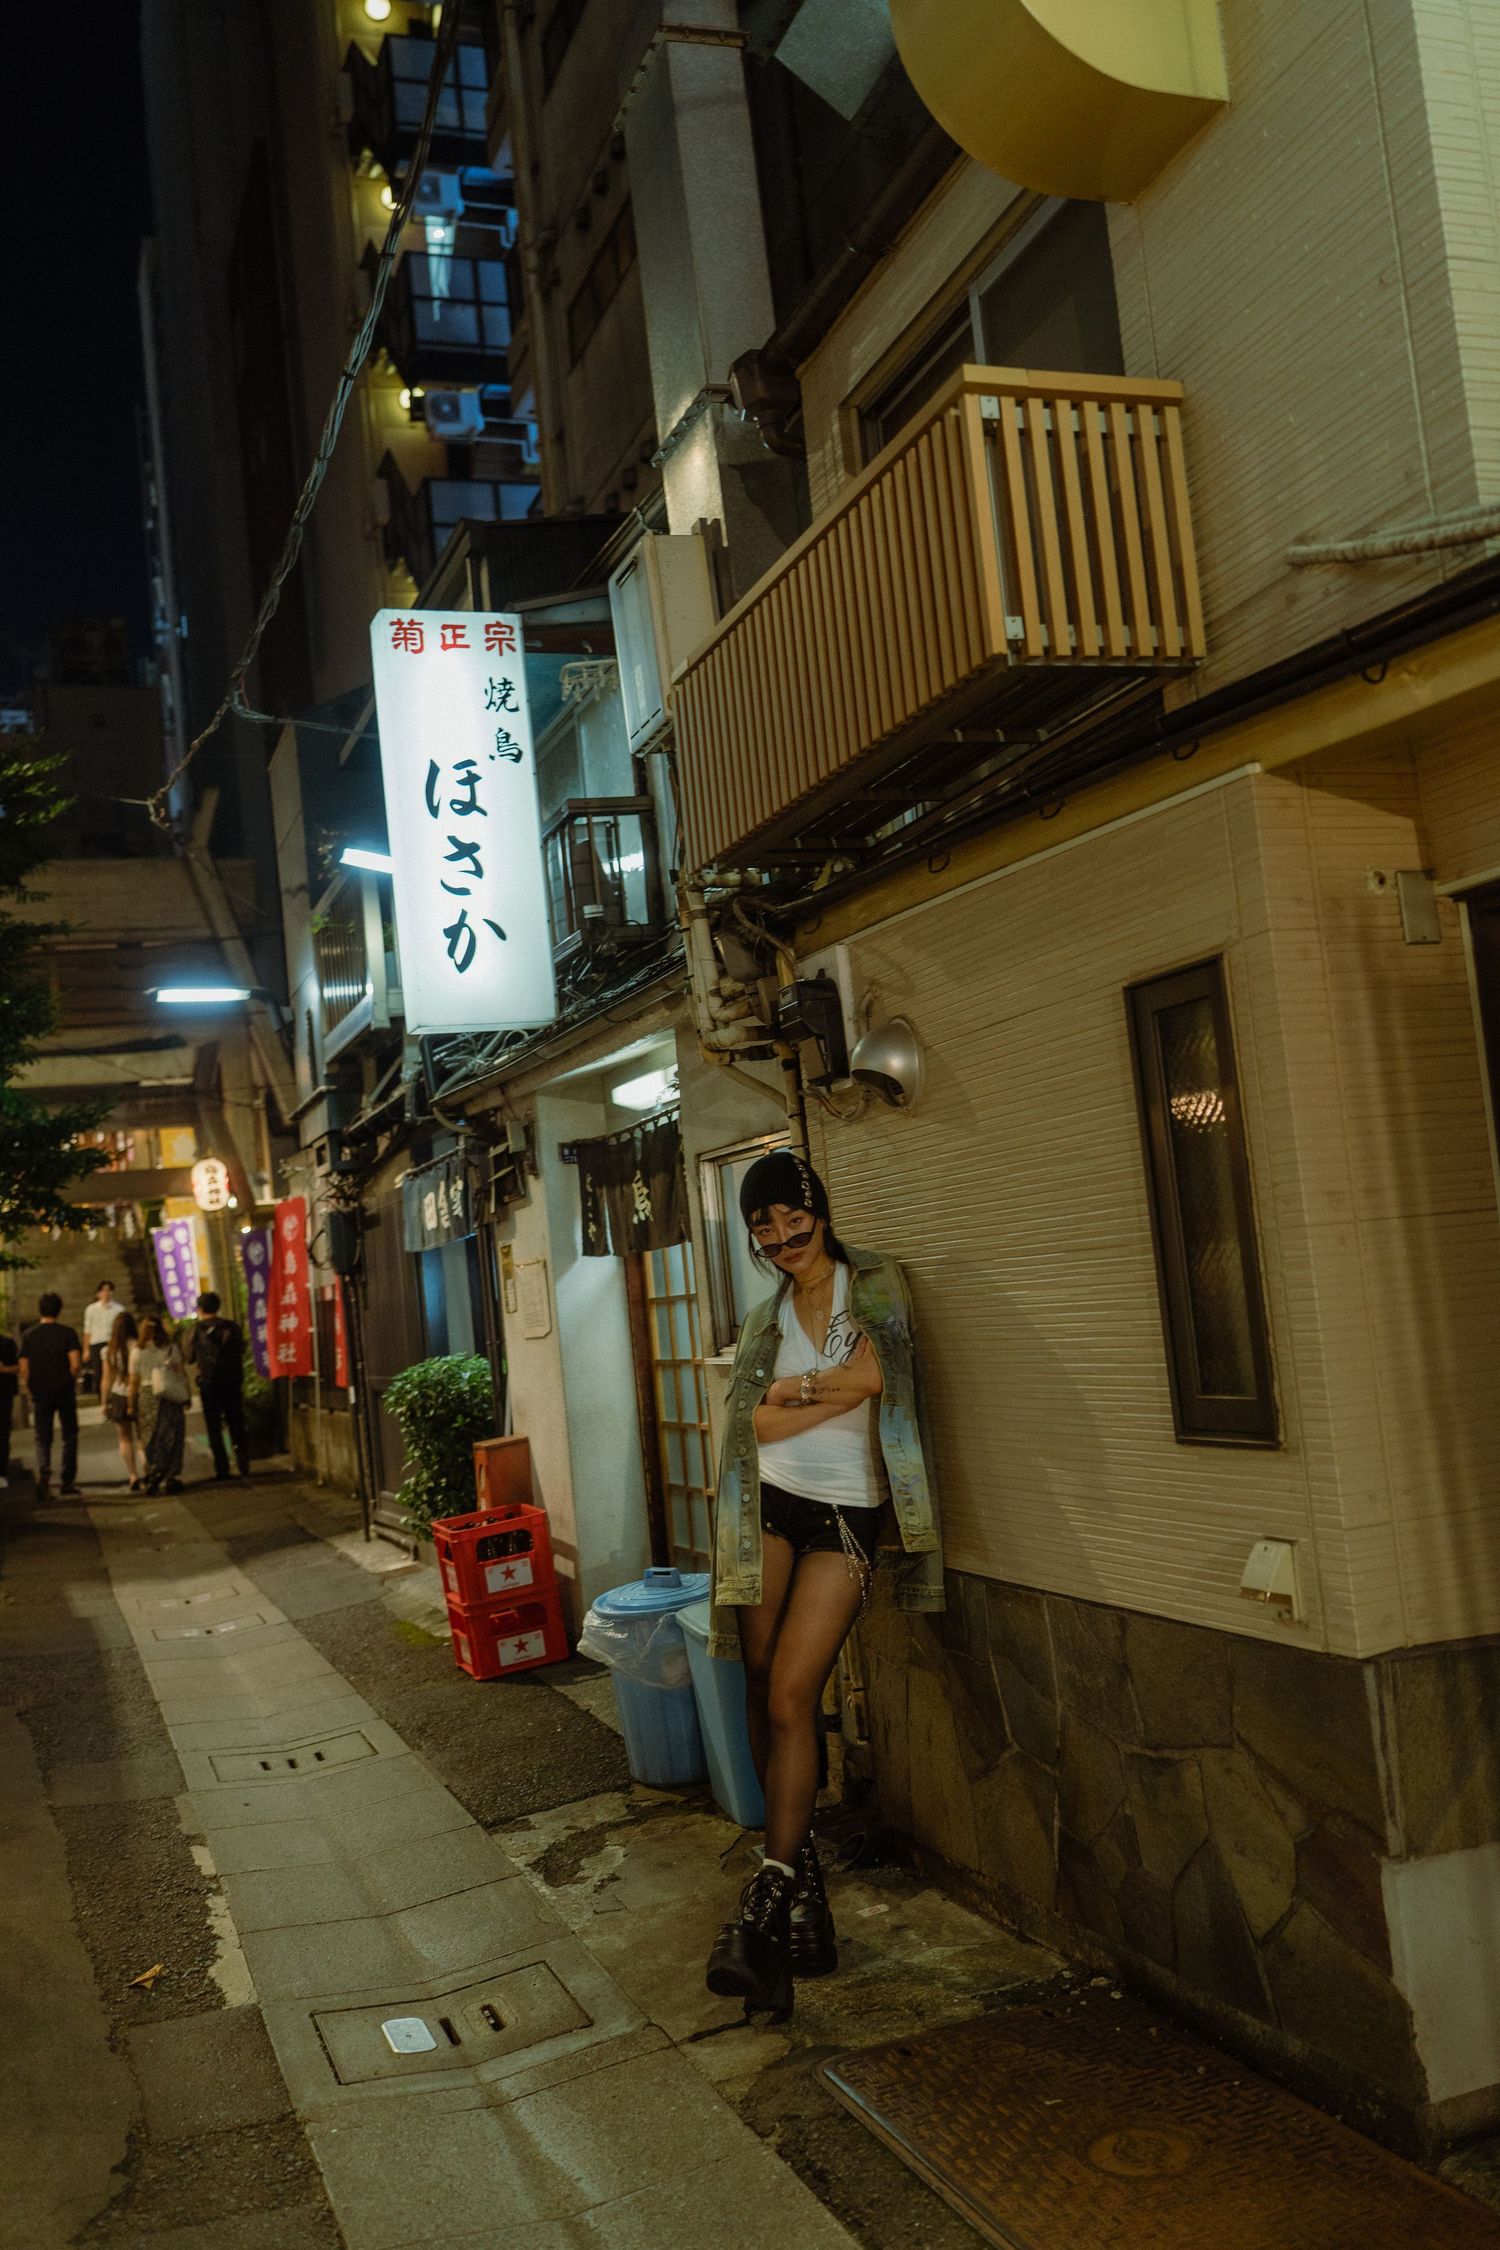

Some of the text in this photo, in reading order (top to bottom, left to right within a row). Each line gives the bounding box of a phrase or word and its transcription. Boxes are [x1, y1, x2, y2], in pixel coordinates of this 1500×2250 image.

[389, 618, 517, 656] 菊正宗
[484, 676, 523, 764] 焼鳥
[425, 758, 507, 975] ほさか
